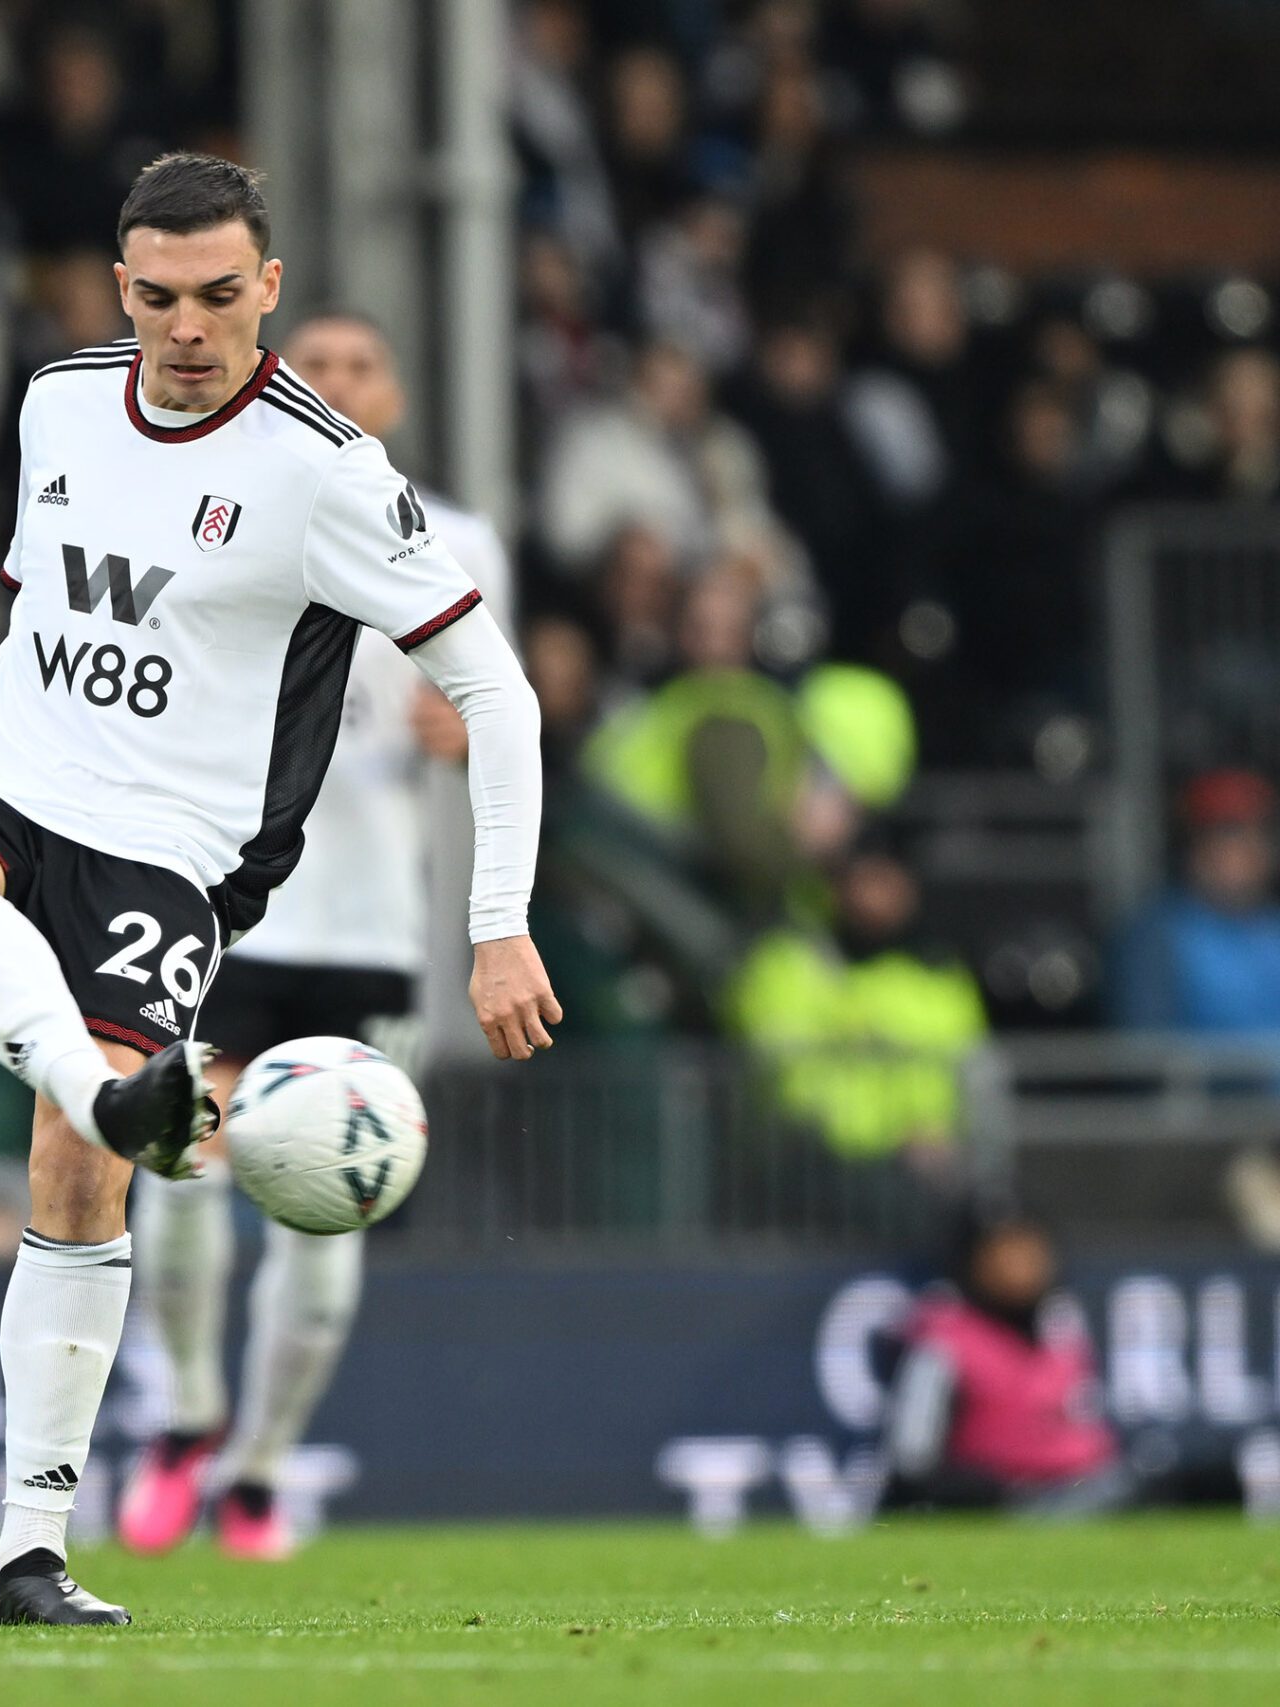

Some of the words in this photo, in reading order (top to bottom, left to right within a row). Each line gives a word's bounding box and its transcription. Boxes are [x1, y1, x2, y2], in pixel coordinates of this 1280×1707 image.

[38, 492, 70, 506] adidas
[33, 631, 172, 718] W88
[94, 910, 205, 1008] 26
[139, 1005, 182, 1036] adidas
